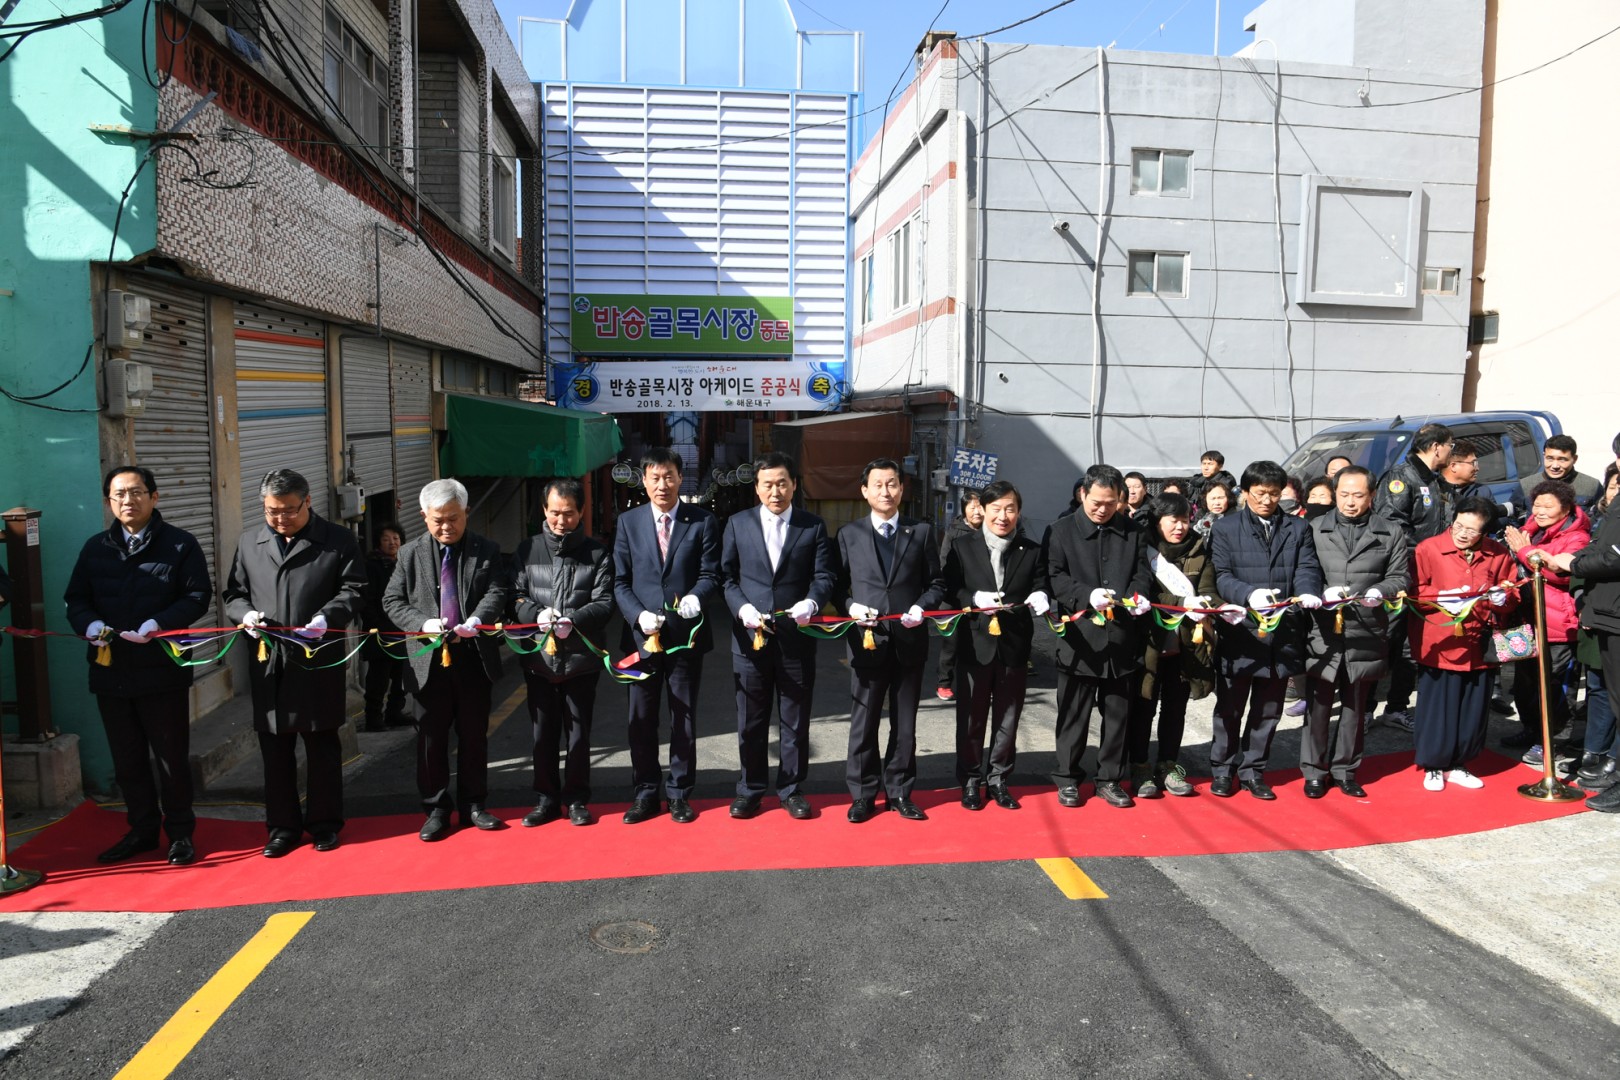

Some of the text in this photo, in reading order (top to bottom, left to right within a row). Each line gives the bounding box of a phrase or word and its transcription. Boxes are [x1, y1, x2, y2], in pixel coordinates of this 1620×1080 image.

[593, 306, 790, 342] 반송골목시장 동문
[573, 379, 591, 398] 경
[609, 377, 801, 397] 반송골목시장 아케이드 준공식
[812, 377, 830, 396] 축
[637, 399, 693, 408] 2018. 2. 13.
[736, 398, 771, 407] 해운대구
